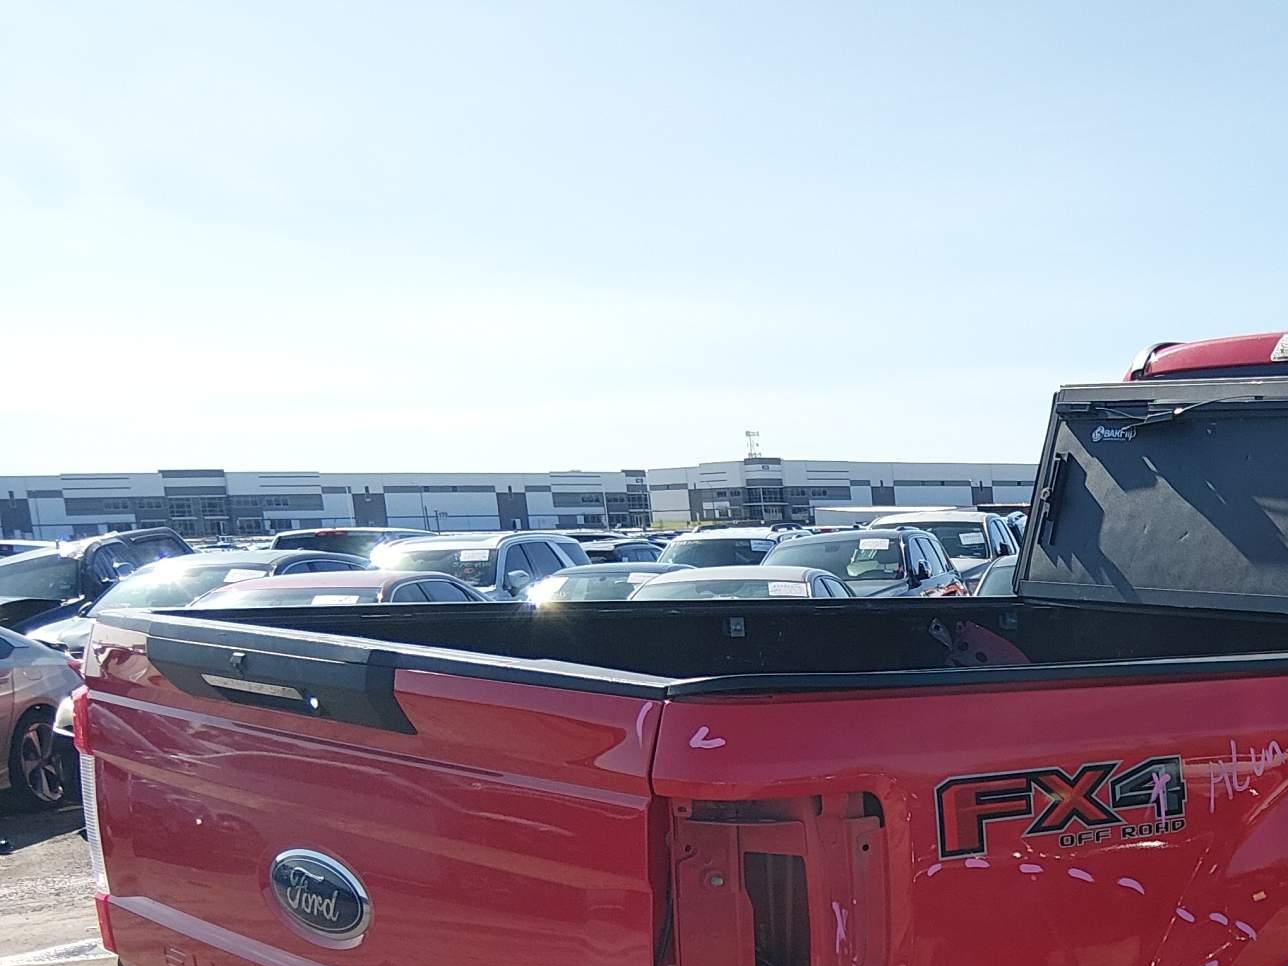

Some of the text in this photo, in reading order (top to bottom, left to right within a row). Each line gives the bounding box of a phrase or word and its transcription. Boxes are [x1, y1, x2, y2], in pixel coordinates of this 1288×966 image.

[934, 754, 1188, 860] FX4
[1058, 818, 1186, 848] OFF ROAD
[287, 867, 339, 921] Ford
